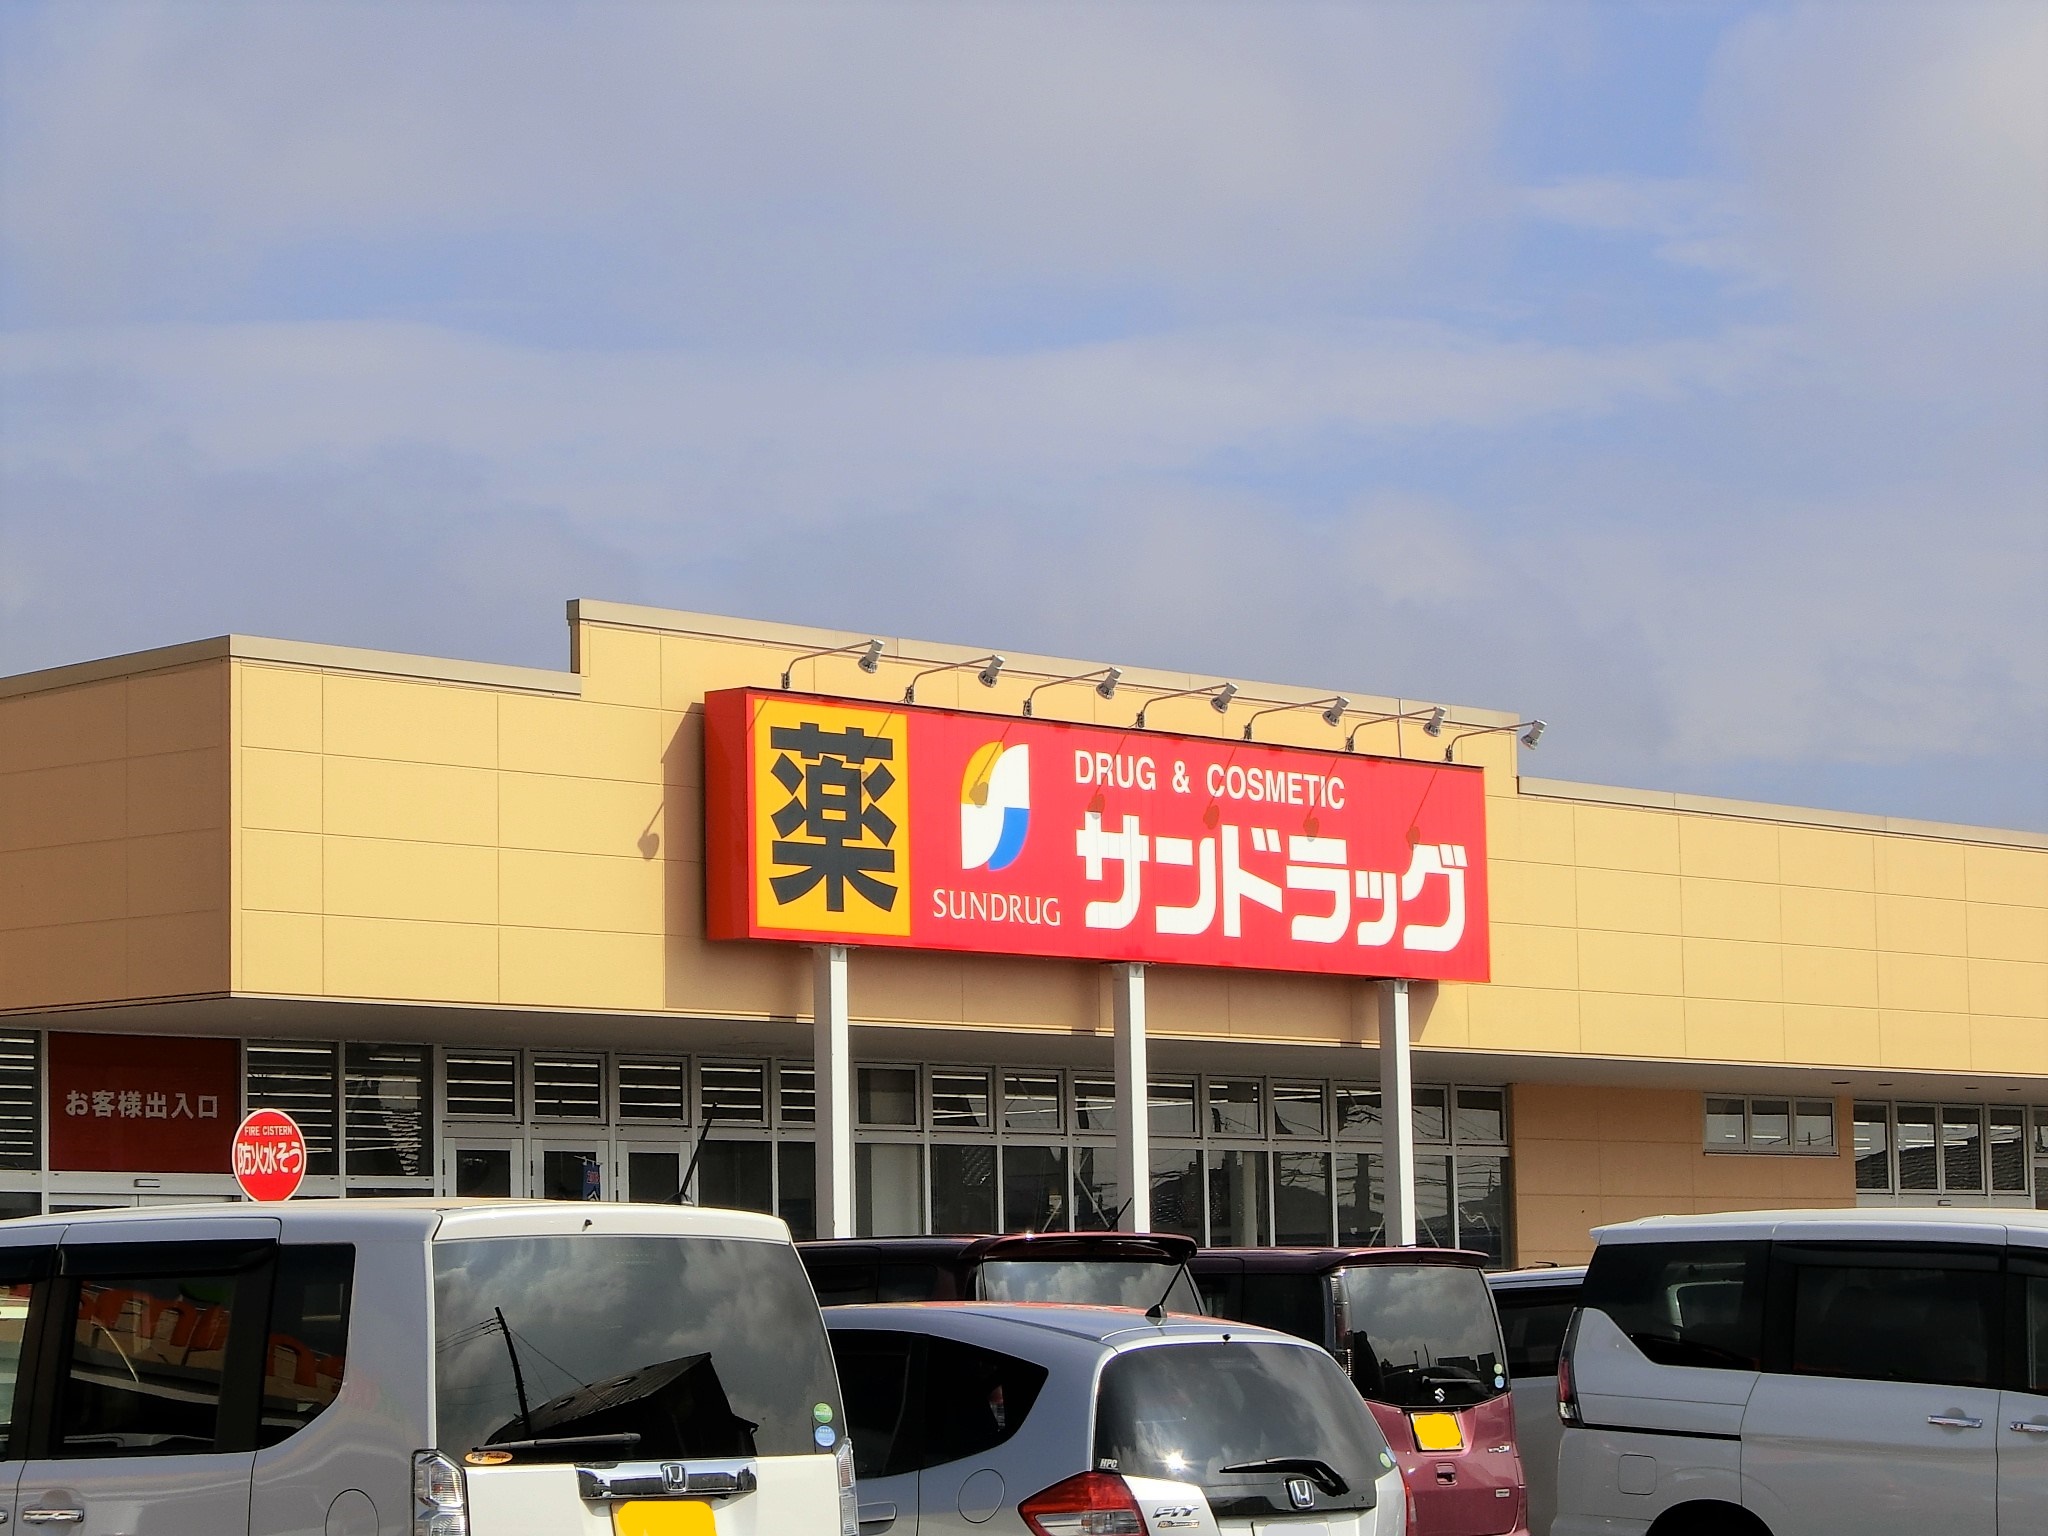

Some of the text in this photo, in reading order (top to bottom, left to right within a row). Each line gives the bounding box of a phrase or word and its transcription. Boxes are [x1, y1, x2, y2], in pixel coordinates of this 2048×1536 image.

[1073, 749, 1346, 810] DRUG & COSMETIC
[769, 721, 899, 913] 薬
[1075, 811, 1469, 953] サンドラッグ
[932, 888, 1062, 927] SUNDRUG
[65, 1089, 219, 1120] お客様出入口
[244, 1125, 293, 1137] FIRE CISTERN
[237, 1141, 303, 1176] 防火水そう
